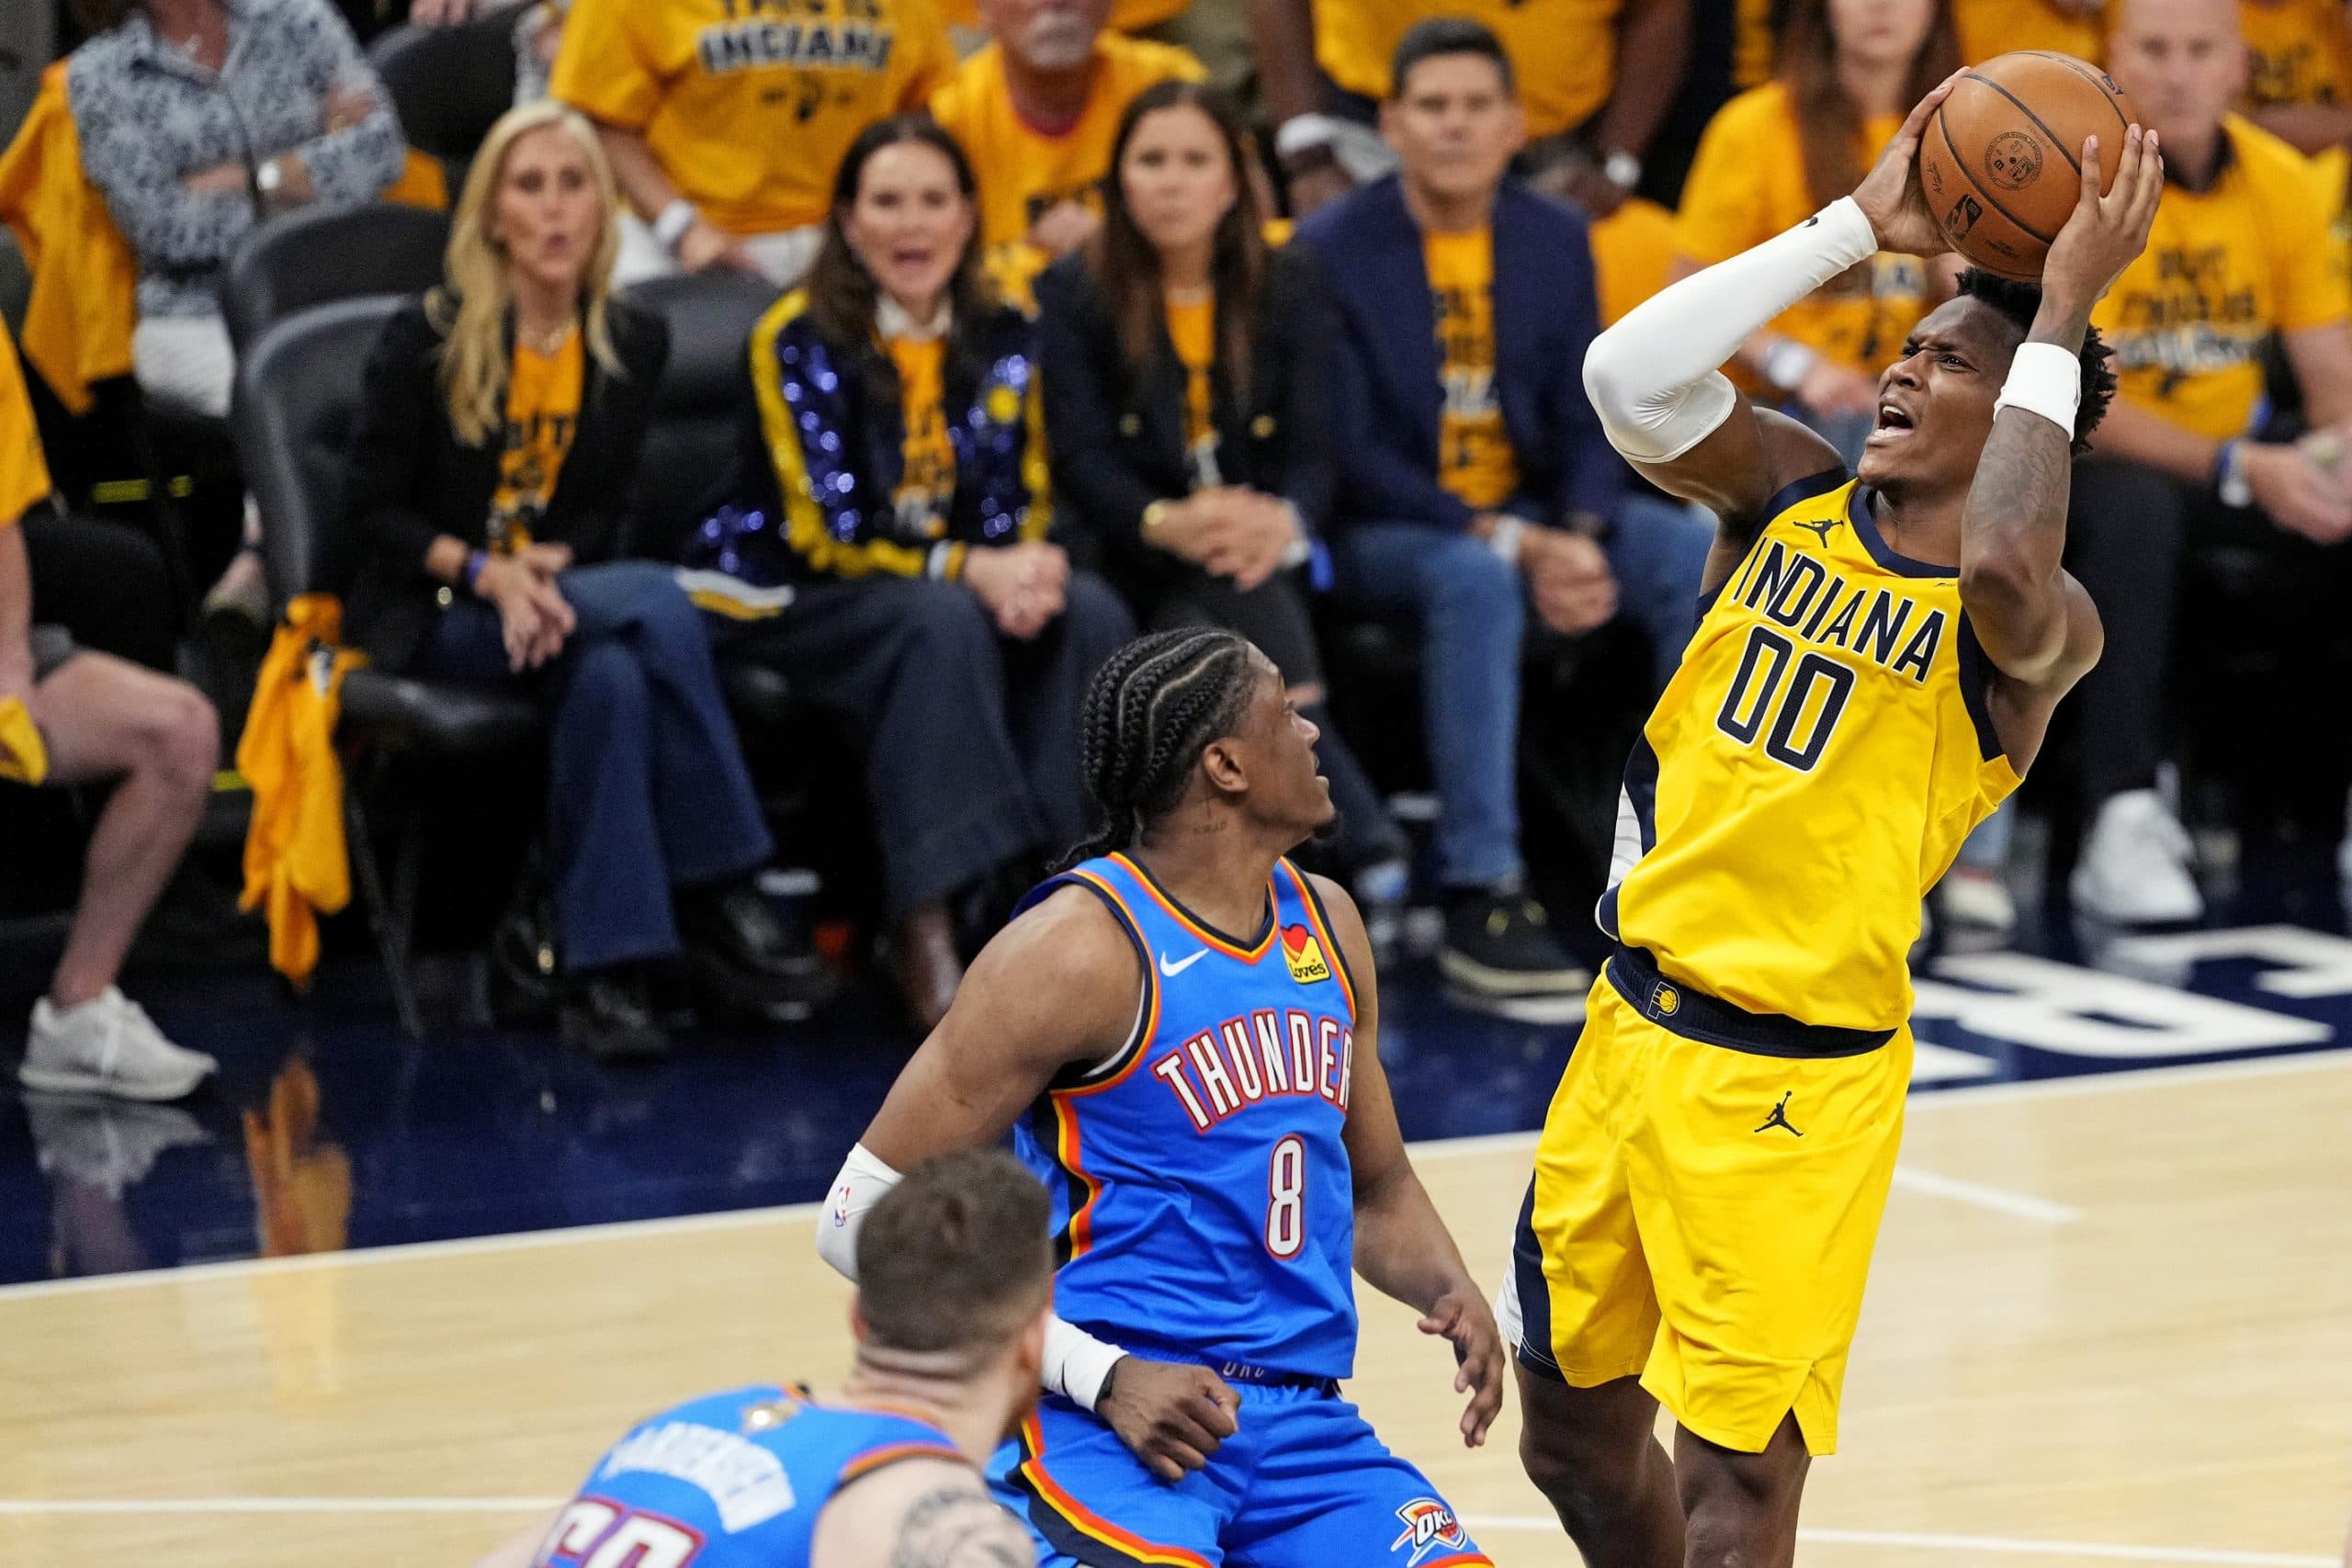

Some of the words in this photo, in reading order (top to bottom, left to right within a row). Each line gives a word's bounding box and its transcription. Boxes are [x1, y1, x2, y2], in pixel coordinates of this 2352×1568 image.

[1732, 536, 1947, 686] INDIANA
[1716, 626, 1857, 773] 00
[1149, 1007, 1354, 1135] THUNDER
[1264, 1133, 1306, 1261] 8
